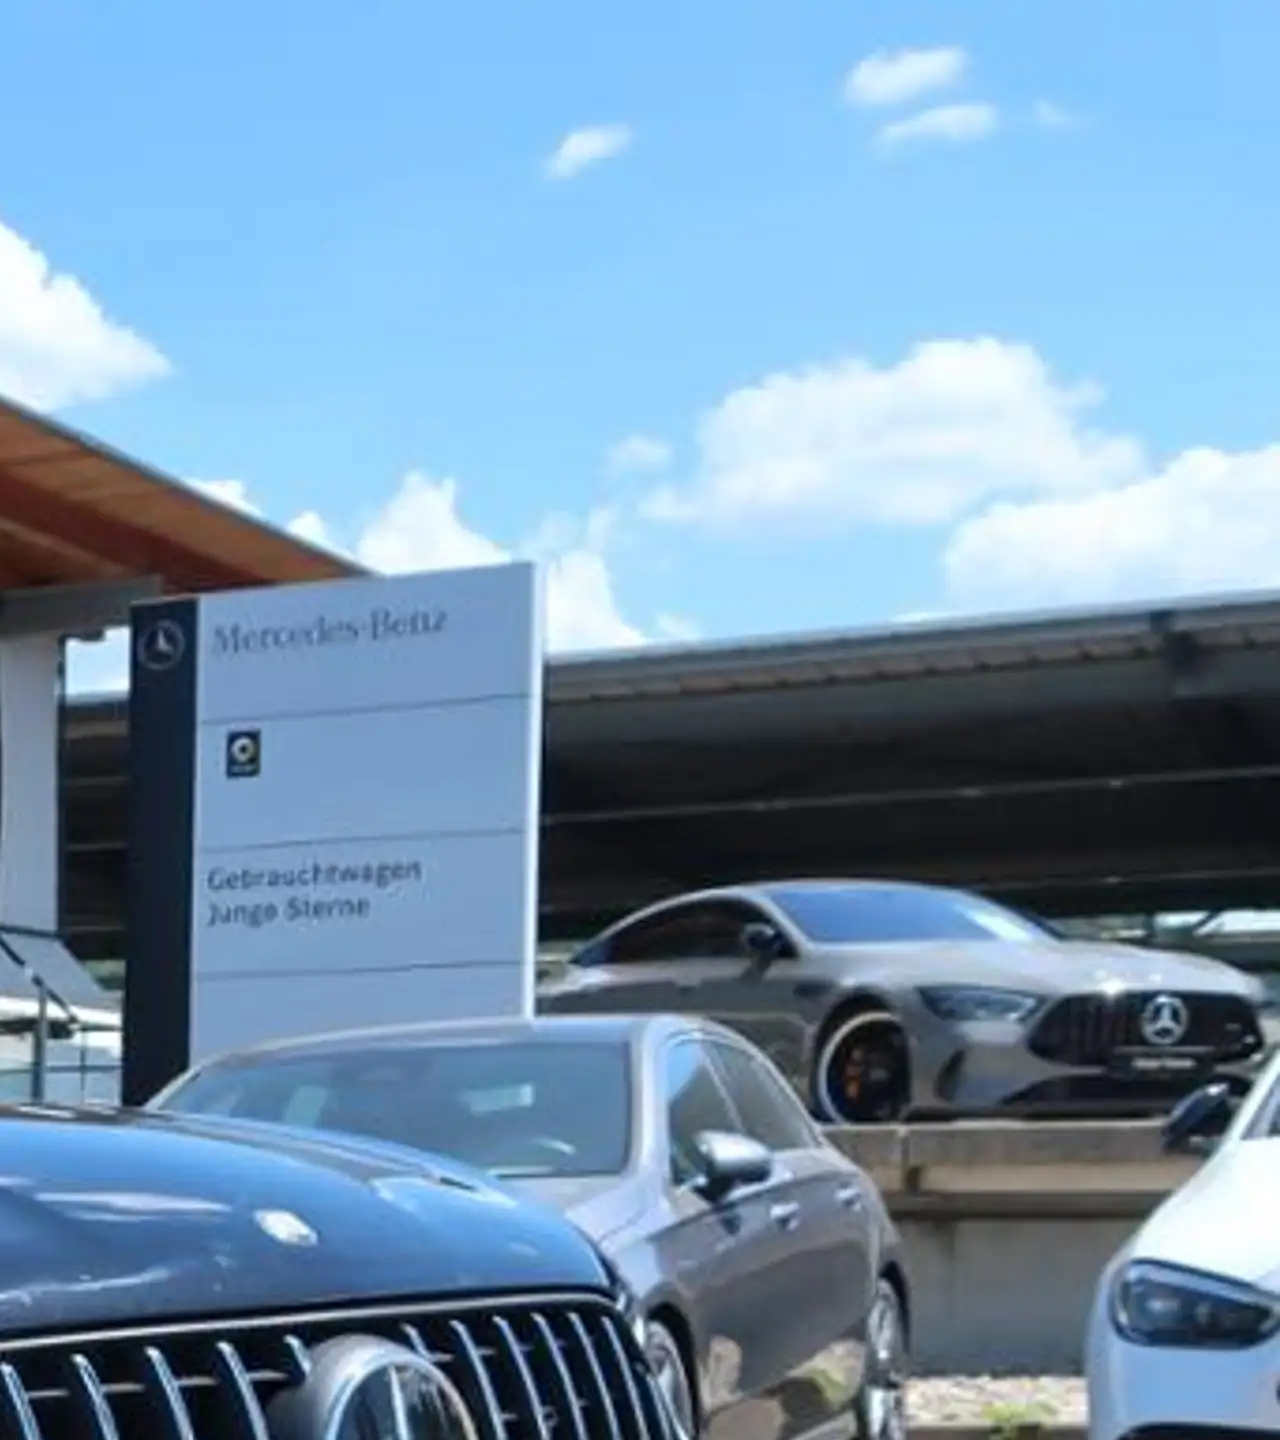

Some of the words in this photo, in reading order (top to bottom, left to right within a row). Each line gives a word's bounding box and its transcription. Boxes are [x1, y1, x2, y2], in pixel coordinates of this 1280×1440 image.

[212, 608, 447, 654] Mercedes-Benz
[206, 860, 423, 890] Gebrauchtwagen
[206, 902, 280, 928] Junge
[284, 896, 371, 922] Sterne
